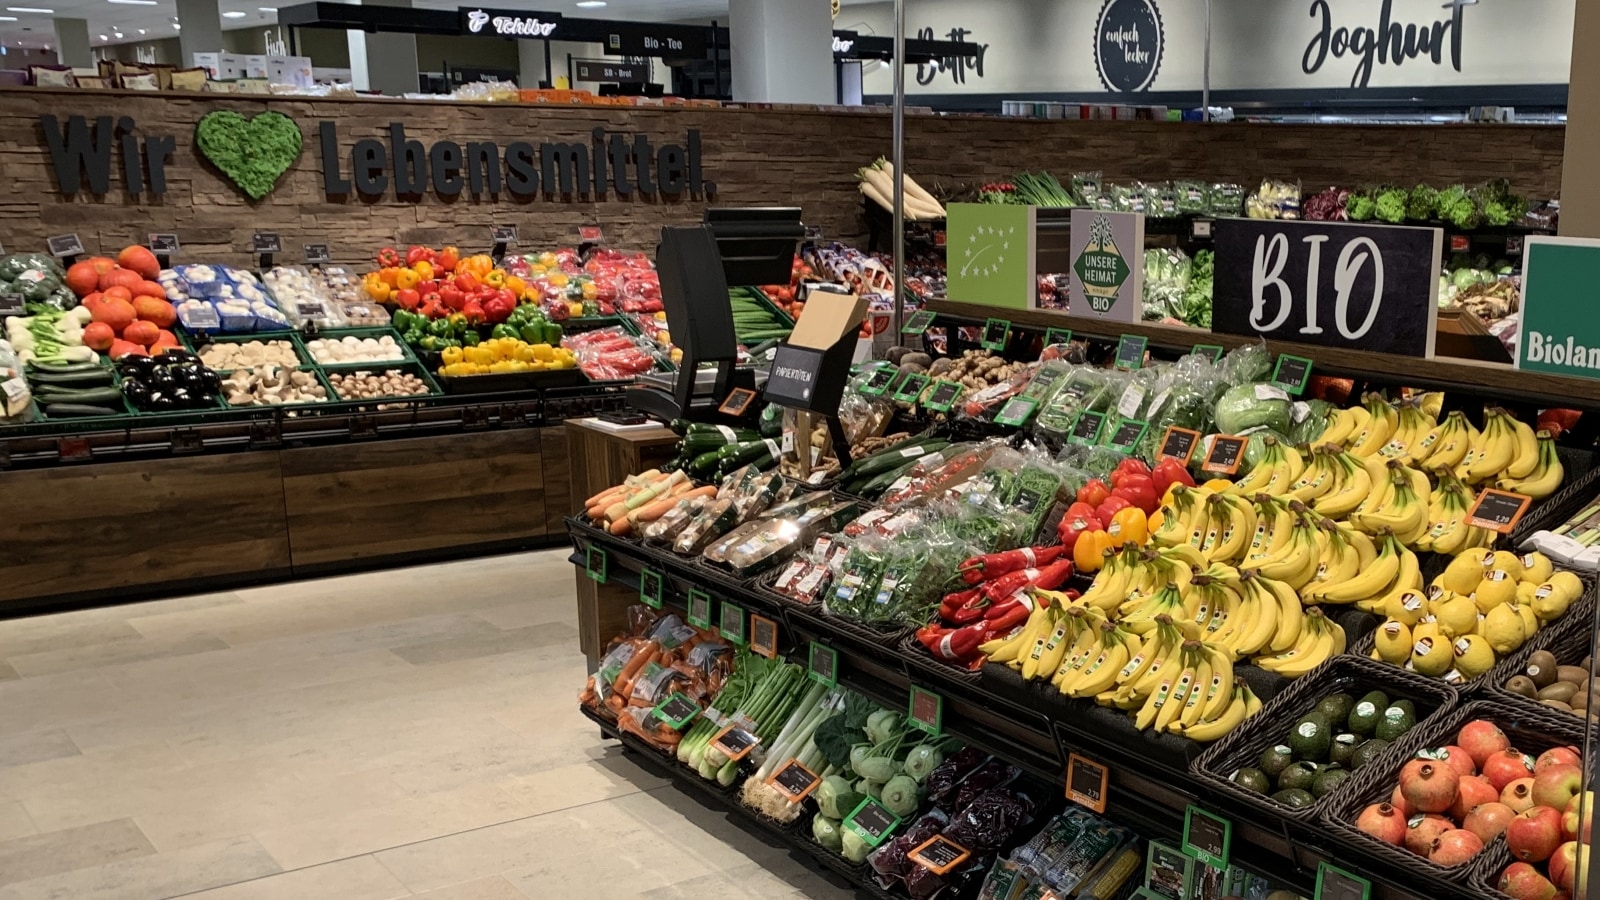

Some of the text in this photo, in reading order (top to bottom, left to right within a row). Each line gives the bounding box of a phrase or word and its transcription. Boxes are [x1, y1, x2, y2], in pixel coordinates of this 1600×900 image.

[492, 17, 557, 36] Tchibo
[1106, 22, 1139, 50] einfach
[644, 37, 659, 48] Bio
[667, 38, 682, 50] Tee
[1302, 0, 1479, 88] Joghurt
[1125, 43, 1150, 64] lecker
[41, 114, 718, 196] Wir Lebensmittel.
[1085, 254, 1117, 270] UNSERE
[1084, 269, 1117, 284] HEIMAT
[1249, 232, 1384, 340] BIO
[1092, 296, 1110, 311] BIO
[1197, 850, 1210, 863] BIO
